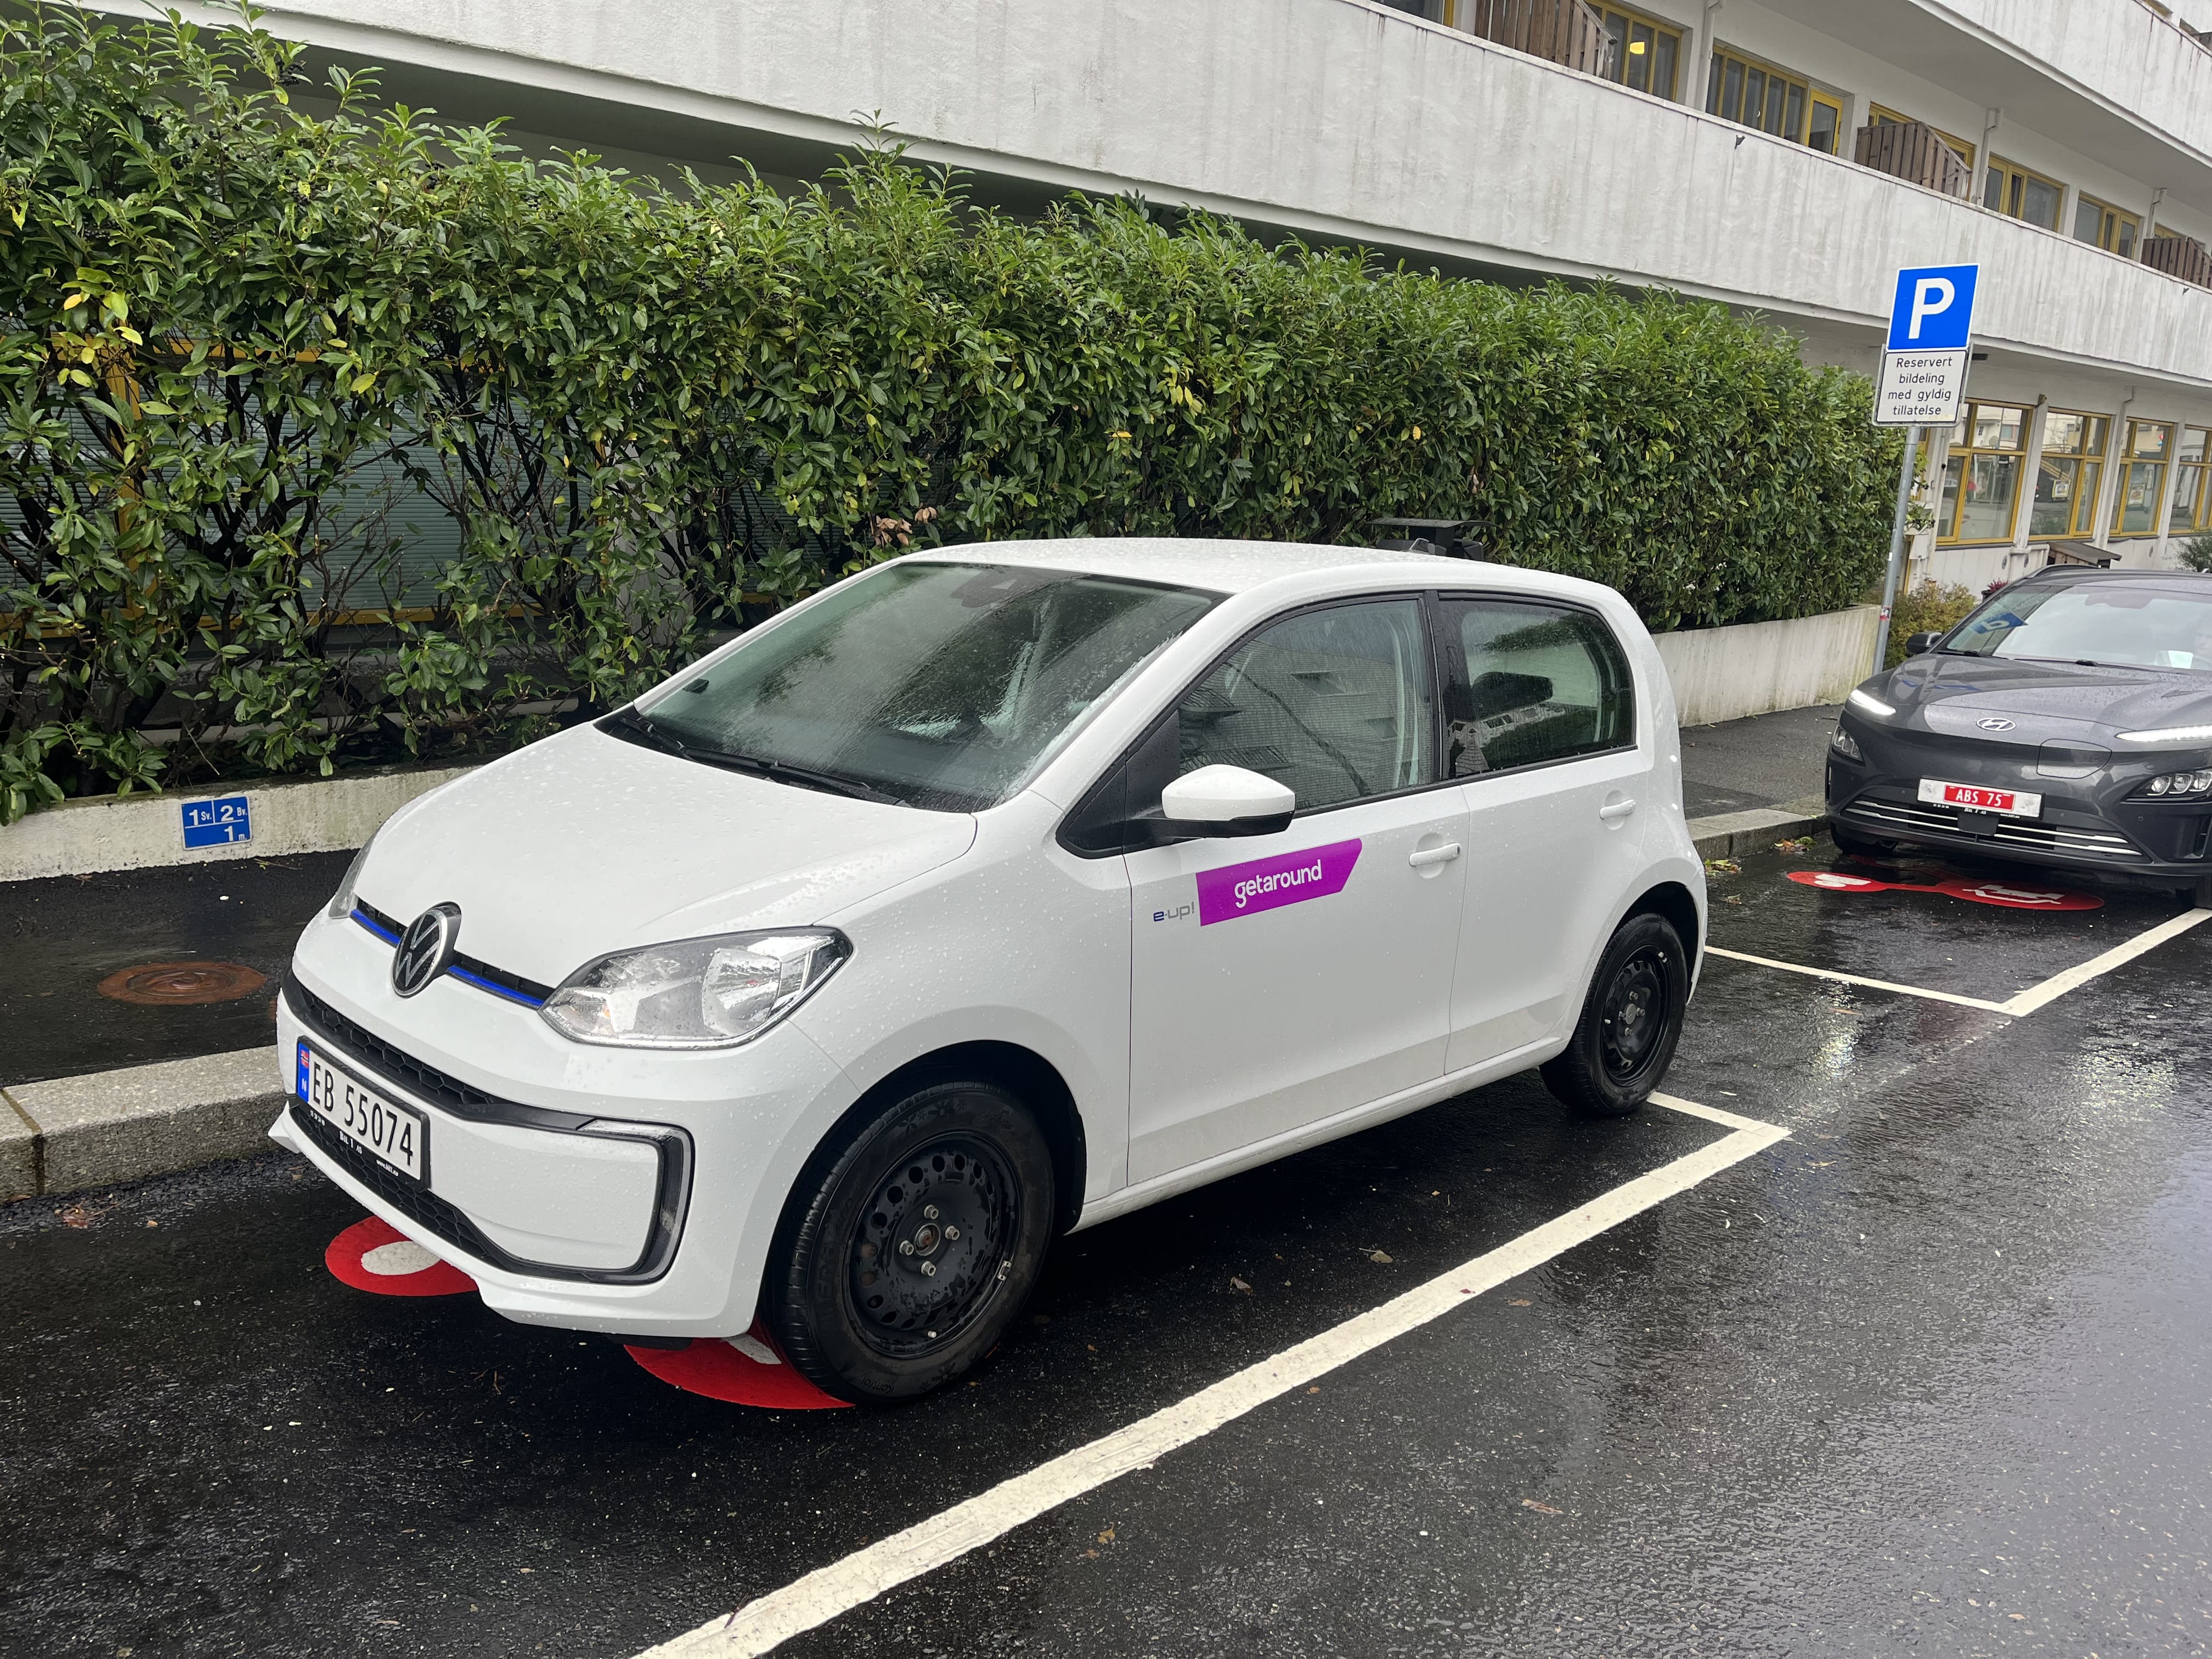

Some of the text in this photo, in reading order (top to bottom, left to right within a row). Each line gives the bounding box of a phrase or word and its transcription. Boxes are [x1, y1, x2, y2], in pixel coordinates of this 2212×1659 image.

[1908, 277, 1955, 340] P
[1896, 356, 1953, 368] Reservert
[1899, 374, 1945, 385] bildeling
[1888, 389, 1951, 402] med gyldig
[1893, 405, 1942, 415] tillatelse
[1955, 788, 2002, 807] ABS 75
[188, 809, 212, 826] 1 Sv.
[220, 805, 248, 822] 2 Bv.
[224, 825, 234, 842] 1
[1234, 859, 1322, 909] getaround
[301, 1061, 413, 1167] N EB 55074
[356, 1145, 363, 1154] AS
